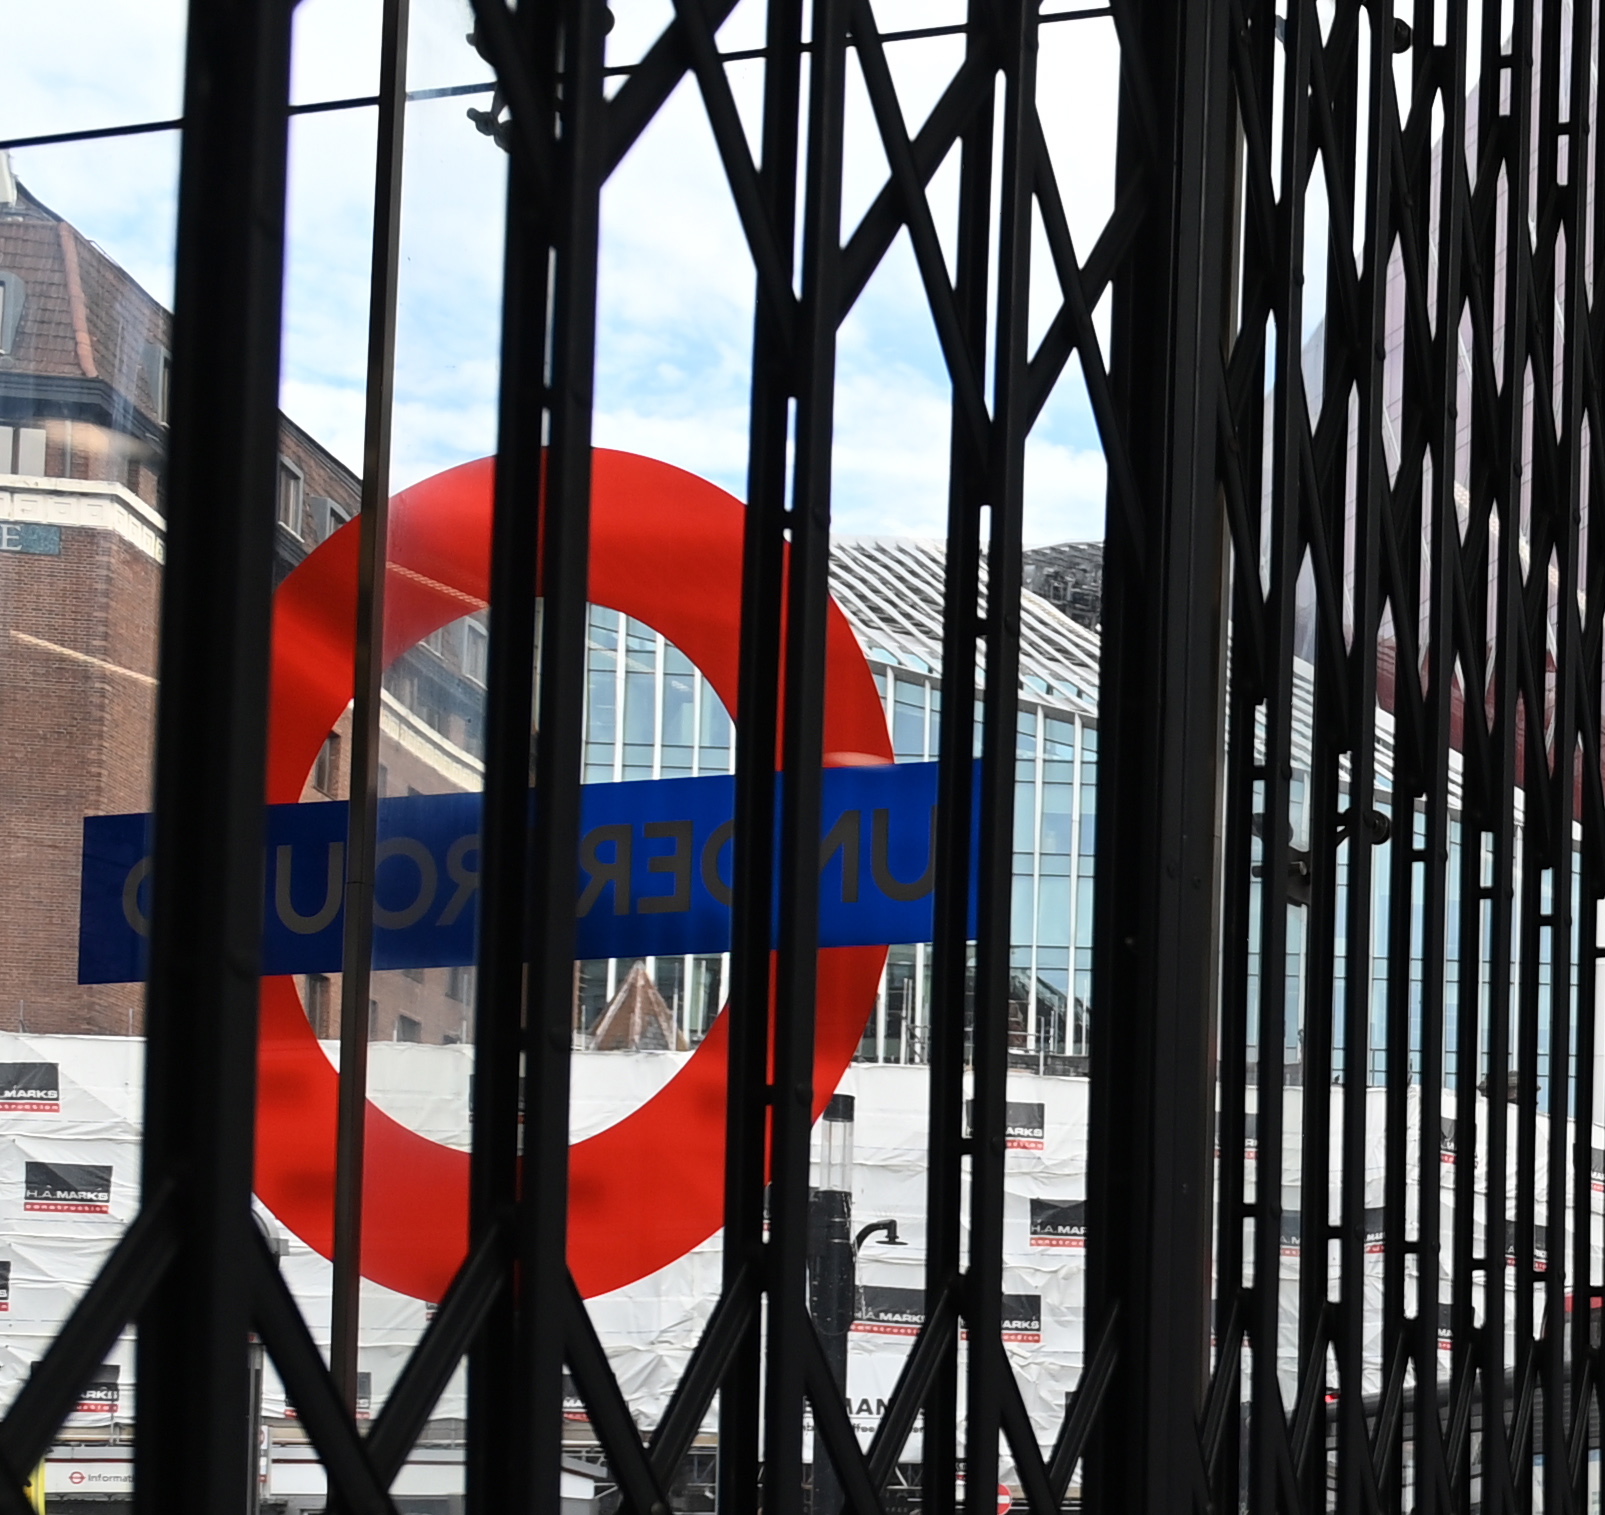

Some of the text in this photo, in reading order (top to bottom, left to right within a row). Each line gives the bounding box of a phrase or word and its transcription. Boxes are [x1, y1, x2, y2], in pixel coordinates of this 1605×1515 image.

[27, 1189, 109, 1200] H.A.MARKS
[1031, 1224, 1087, 1235] H.A.MAR
[88, 1473, 133, 1483] Informat
